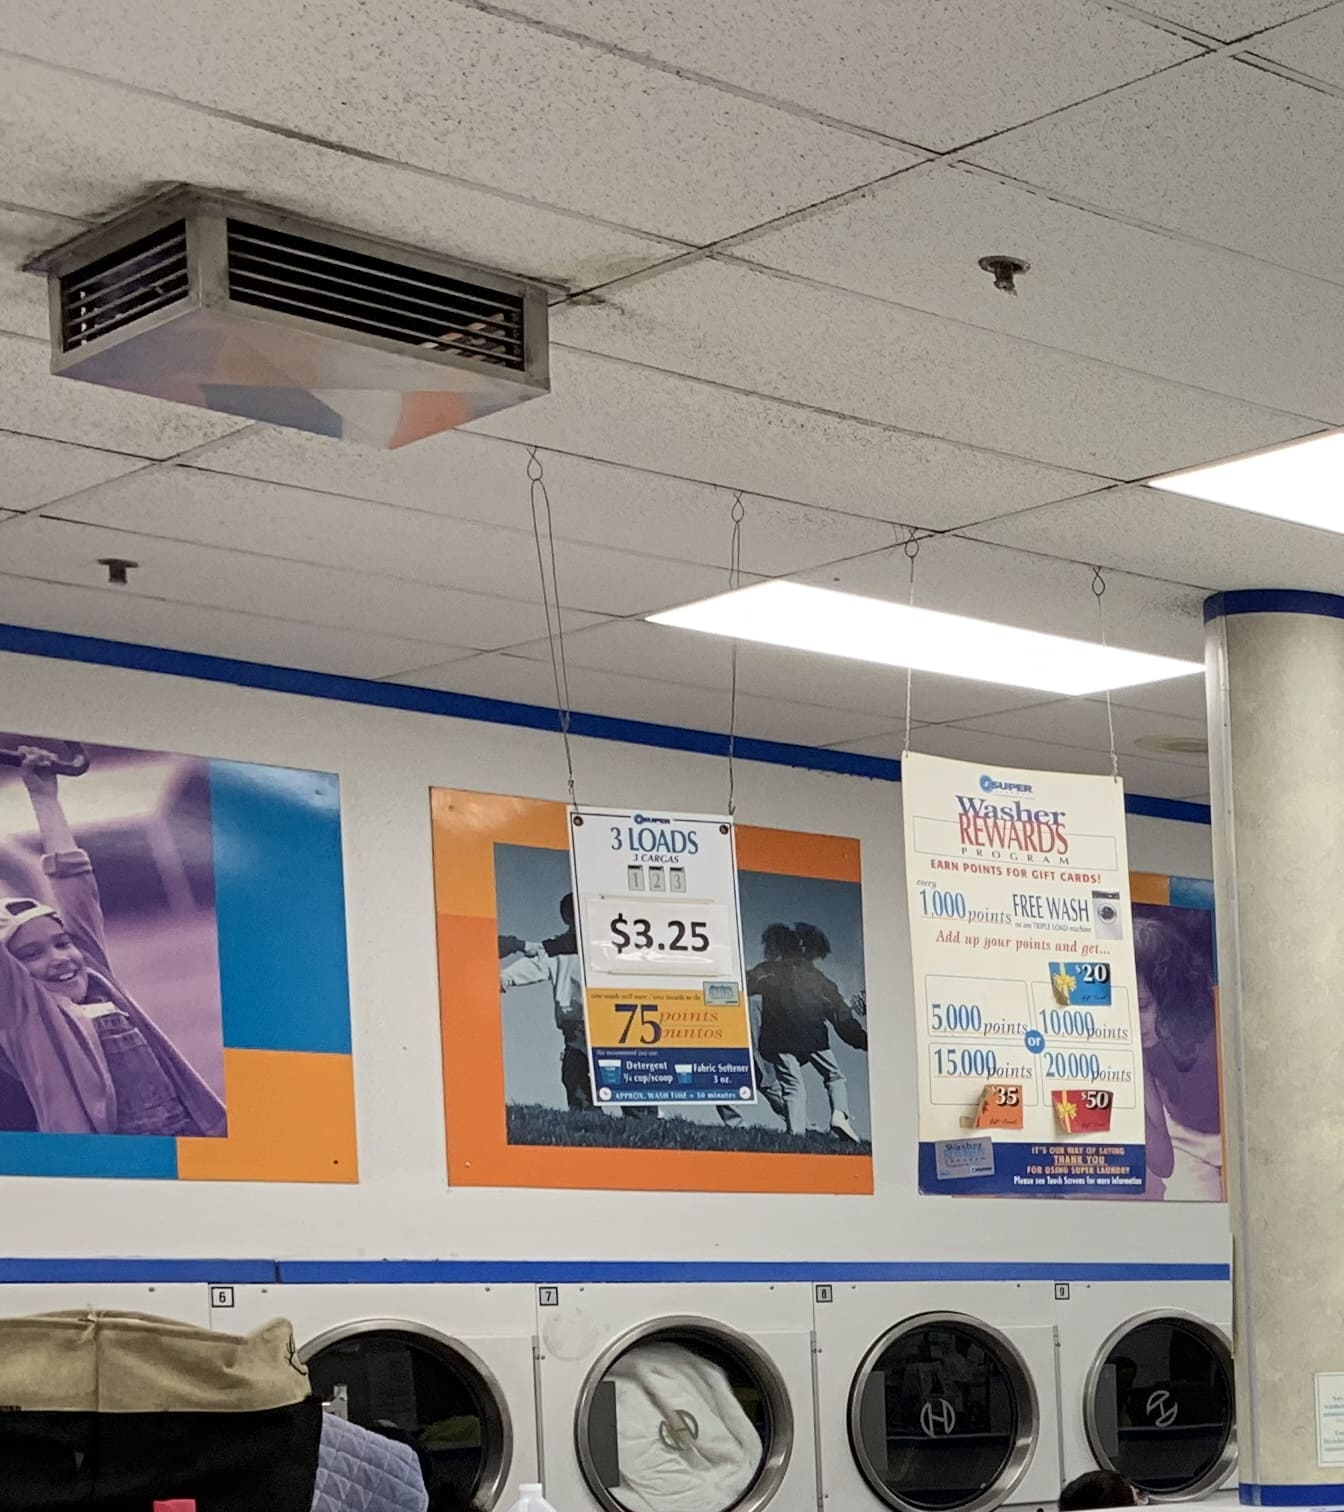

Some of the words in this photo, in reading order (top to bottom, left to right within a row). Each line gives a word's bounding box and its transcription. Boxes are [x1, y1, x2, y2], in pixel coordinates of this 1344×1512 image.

[991, 780, 1033, 794] SUPER
[955, 794, 1067, 825] Washer
[610, 827, 623, 850] 3
[628, 827, 699, 856] LOADS
[958, 812, 1070, 856] REWARDS
[632, 853, 639, 862] 3
[641, 854, 680, 864] CARGAS
[961, 846, 1071, 866] PROGRAM
[930, 858, 960, 872] EARN
[963, 862, 1003, 877] POINTS
[1006, 866, 1029, 879] FOR
[1031, 869, 1056, 881] GIFT
[1060, 872, 1102, 885] CARDS!
[916, 879, 937, 889] every
[919, 888, 967, 920] 1,000
[967, 906, 1013, 925] points
[1012, 893, 1043, 920] FREE
[1045, 897, 1090, 923] WASH
[610, 912, 710, 954] $3.25
[935, 928, 961, 944] Add
[964, 934, 980, 949] up
[982, 936, 1011, 950] your
[1014, 937, 1051, 953] points
[1054, 940, 1078, 954] and
[1074, 963, 1107, 983] $20
[614, 1003, 663, 1045] 75
[659, 1010, 719, 1025] points
[931, 1003, 982, 1033] 5,000
[983, 1018, 1029, 1037] points
[1039, 1009, 1095, 1038] 10,000
[1087, 1023, 1129, 1041] points
[1026, 1036, 1042, 1047] or
[626, 1060, 669, 1073] Detergent
[693, 1063, 716, 1074] Fabric
[717, 1063, 749, 1075] Softener
[933, 1049, 997, 1078] 15,000
[986, 1062, 1034, 1081] points
[1043, 1051, 1100, 1081] 20,000
[1090, 1066, 1133, 1084] points
[634, 1073, 674, 1085] cup/scoop
[712, 1074, 719, 1084] 3
[647, 1091, 670, 1100] WASH
[1080, 1090, 1109, 1109] $50
[1054, 1156, 1083, 1166] THANK
[1026, 1166, 1044, 1175] FOR
[1070, 1166, 1095, 1175] SUPER
[1013, 1176, 1034, 1186] Please
[1034, 1176, 1047, 1185] see
[218, 1291, 226, 1304] 6
[545, 1291, 551, 1302] 7
[1059, 1287, 1065, 1297] 9
